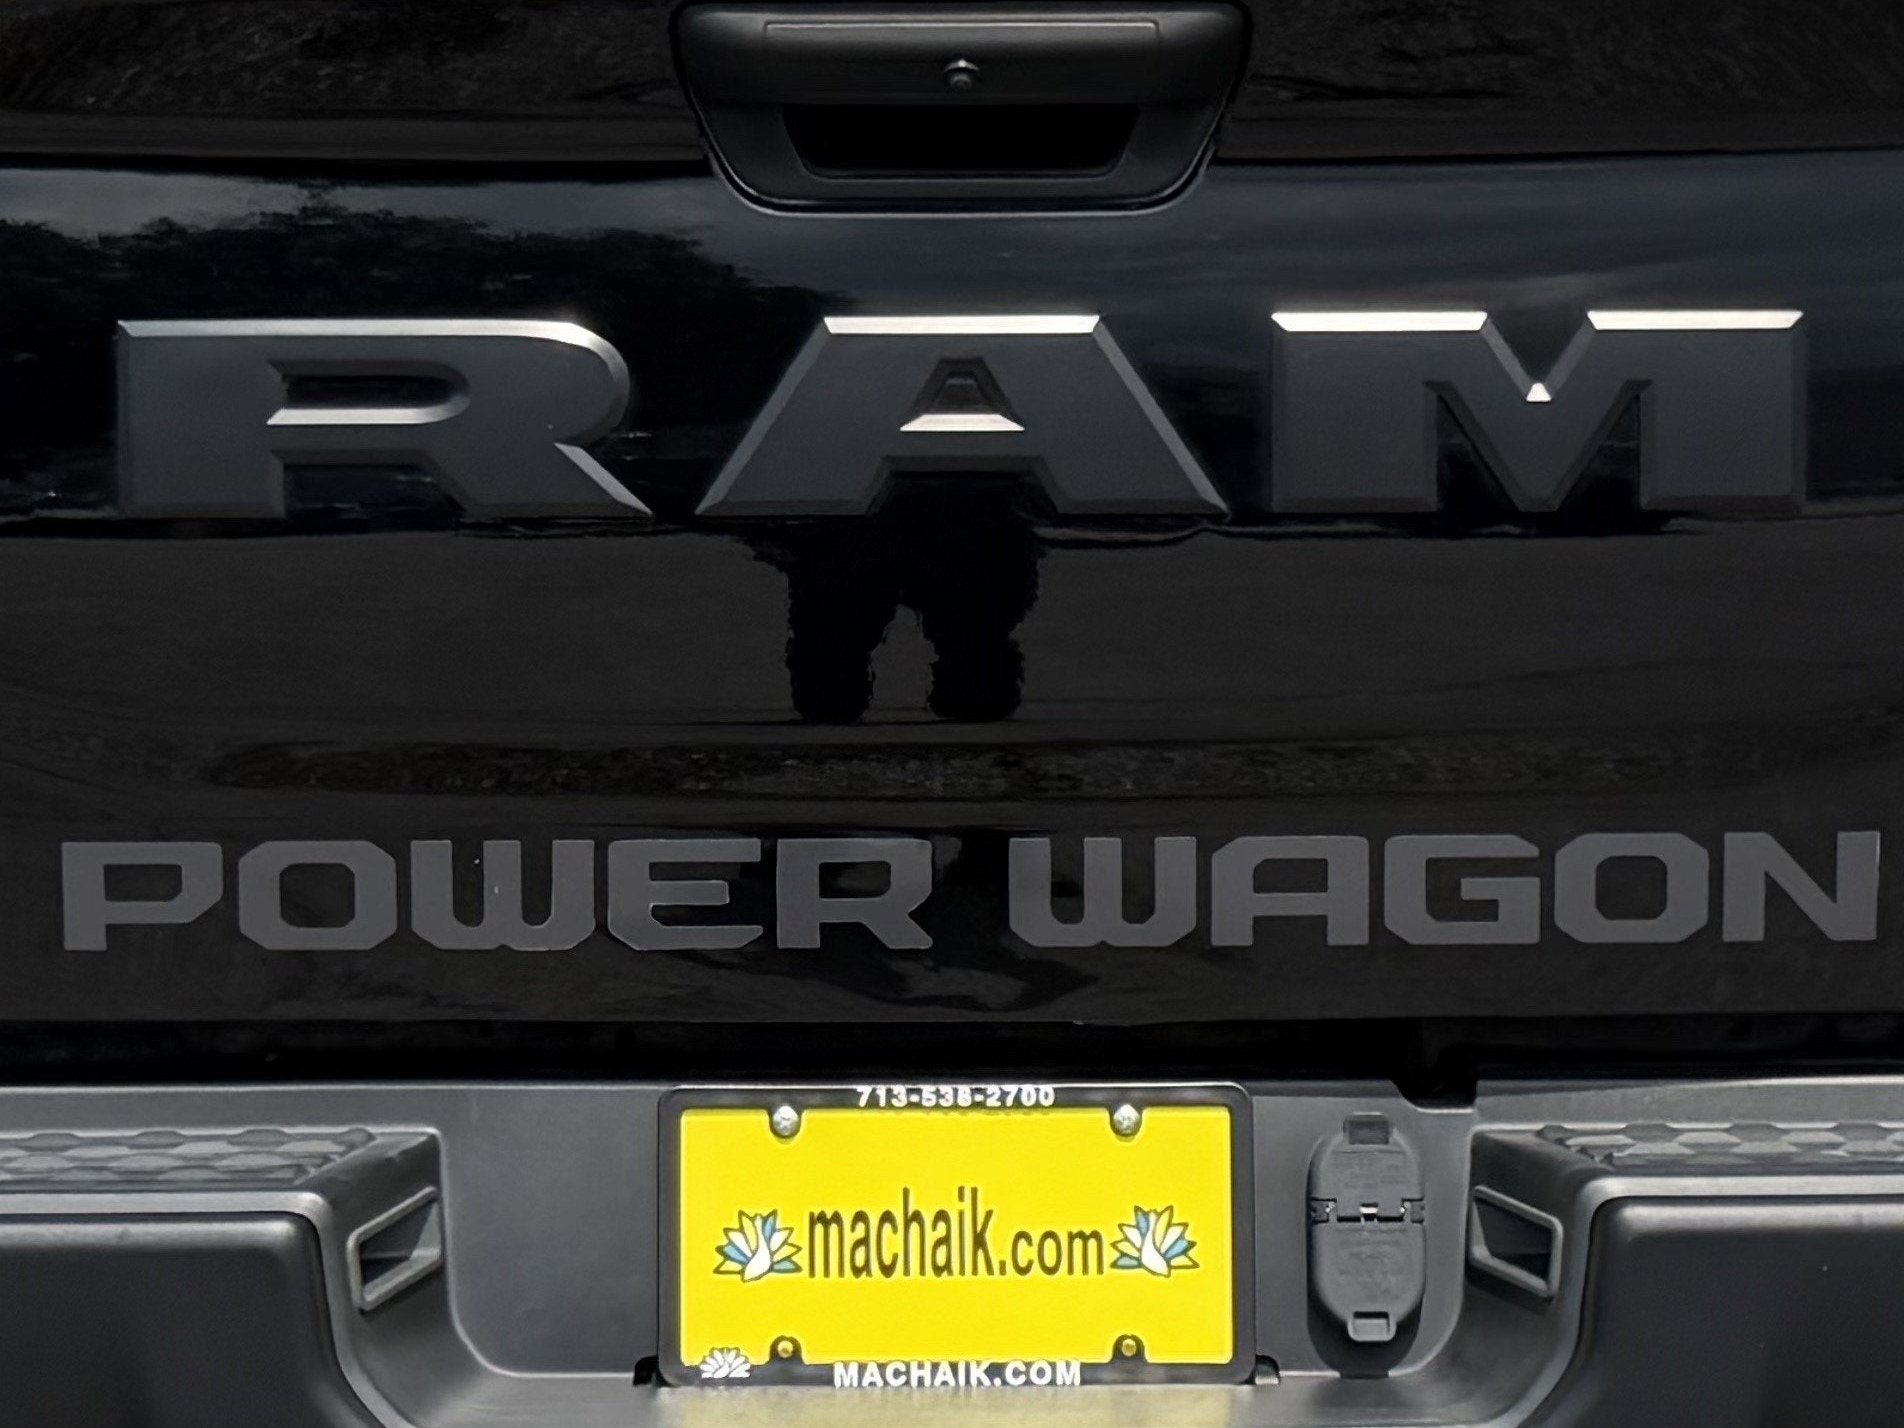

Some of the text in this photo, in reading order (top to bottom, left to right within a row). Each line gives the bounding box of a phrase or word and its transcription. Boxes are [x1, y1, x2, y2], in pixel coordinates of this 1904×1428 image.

[118, 310, 1805, 518] RAM
[61, 830, 1881, 952] POWER WAGON
[857, 1085, 1055, 1107] 713-538-2700
[808, 1186, 1104, 1278] machaik.com
[833, 1360, 1081, 1388] MACHAIK.COM
